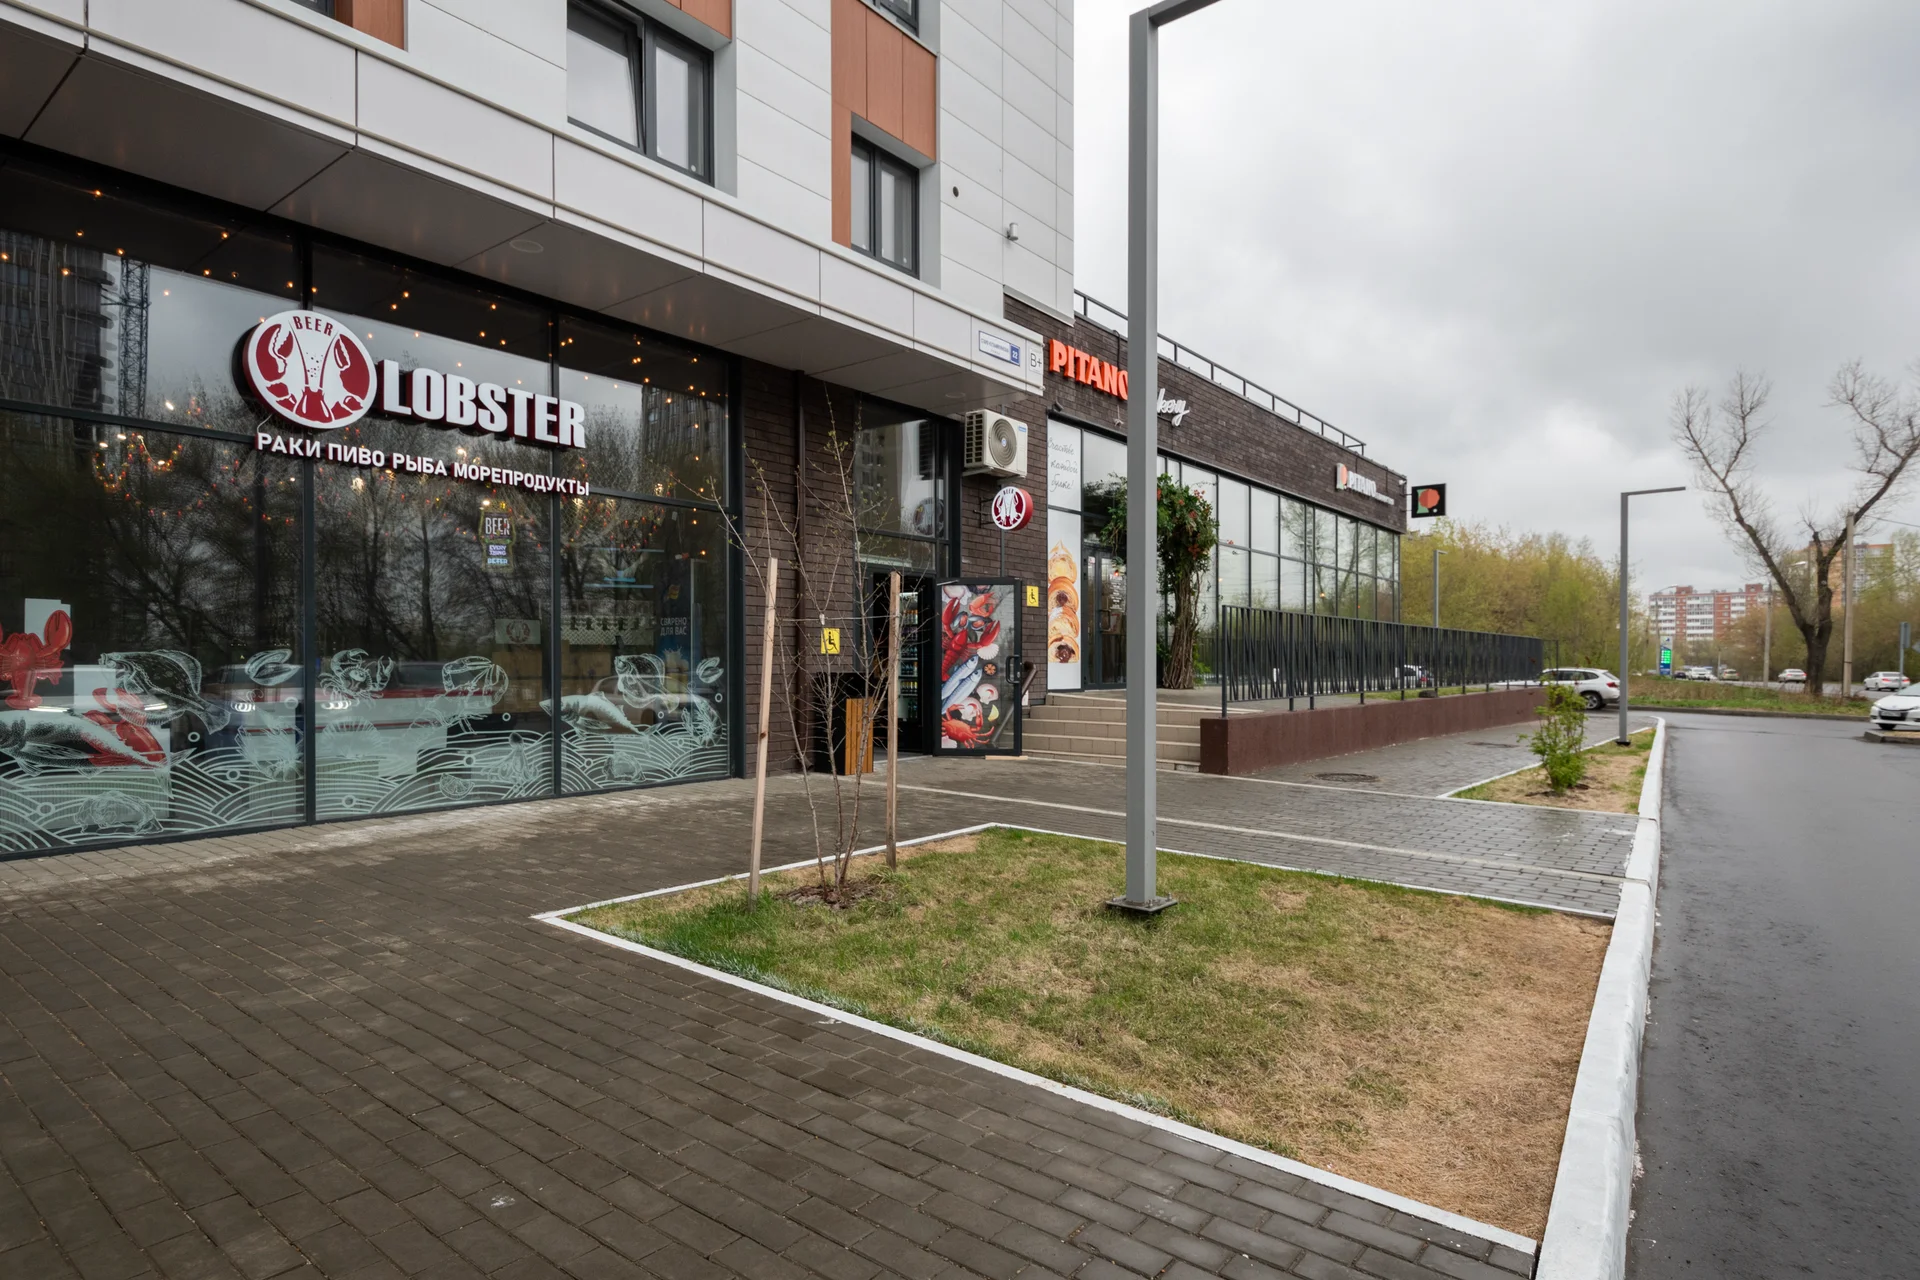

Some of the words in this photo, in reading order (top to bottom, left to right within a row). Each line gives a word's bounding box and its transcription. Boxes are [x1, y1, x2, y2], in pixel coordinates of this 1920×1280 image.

[292, 315, 334, 337] BEER
[380, 359, 586, 448] LOBSTER
[1157, 388, 1190, 426] kery
[256, 432, 321, 459] РАКИ
[326, 442, 385, 468] ПИВО
[391, 452, 447, 477] РЫБА
[452, 462, 590, 496] МОРЕПРОДУКТЫ
[485, 517, 510, 536] BEER
[660, 616, 688, 626] СВАРЕНО
[660, 626, 674, 637] ДЛЯ
[675, 626, 688, 636] ВАС
